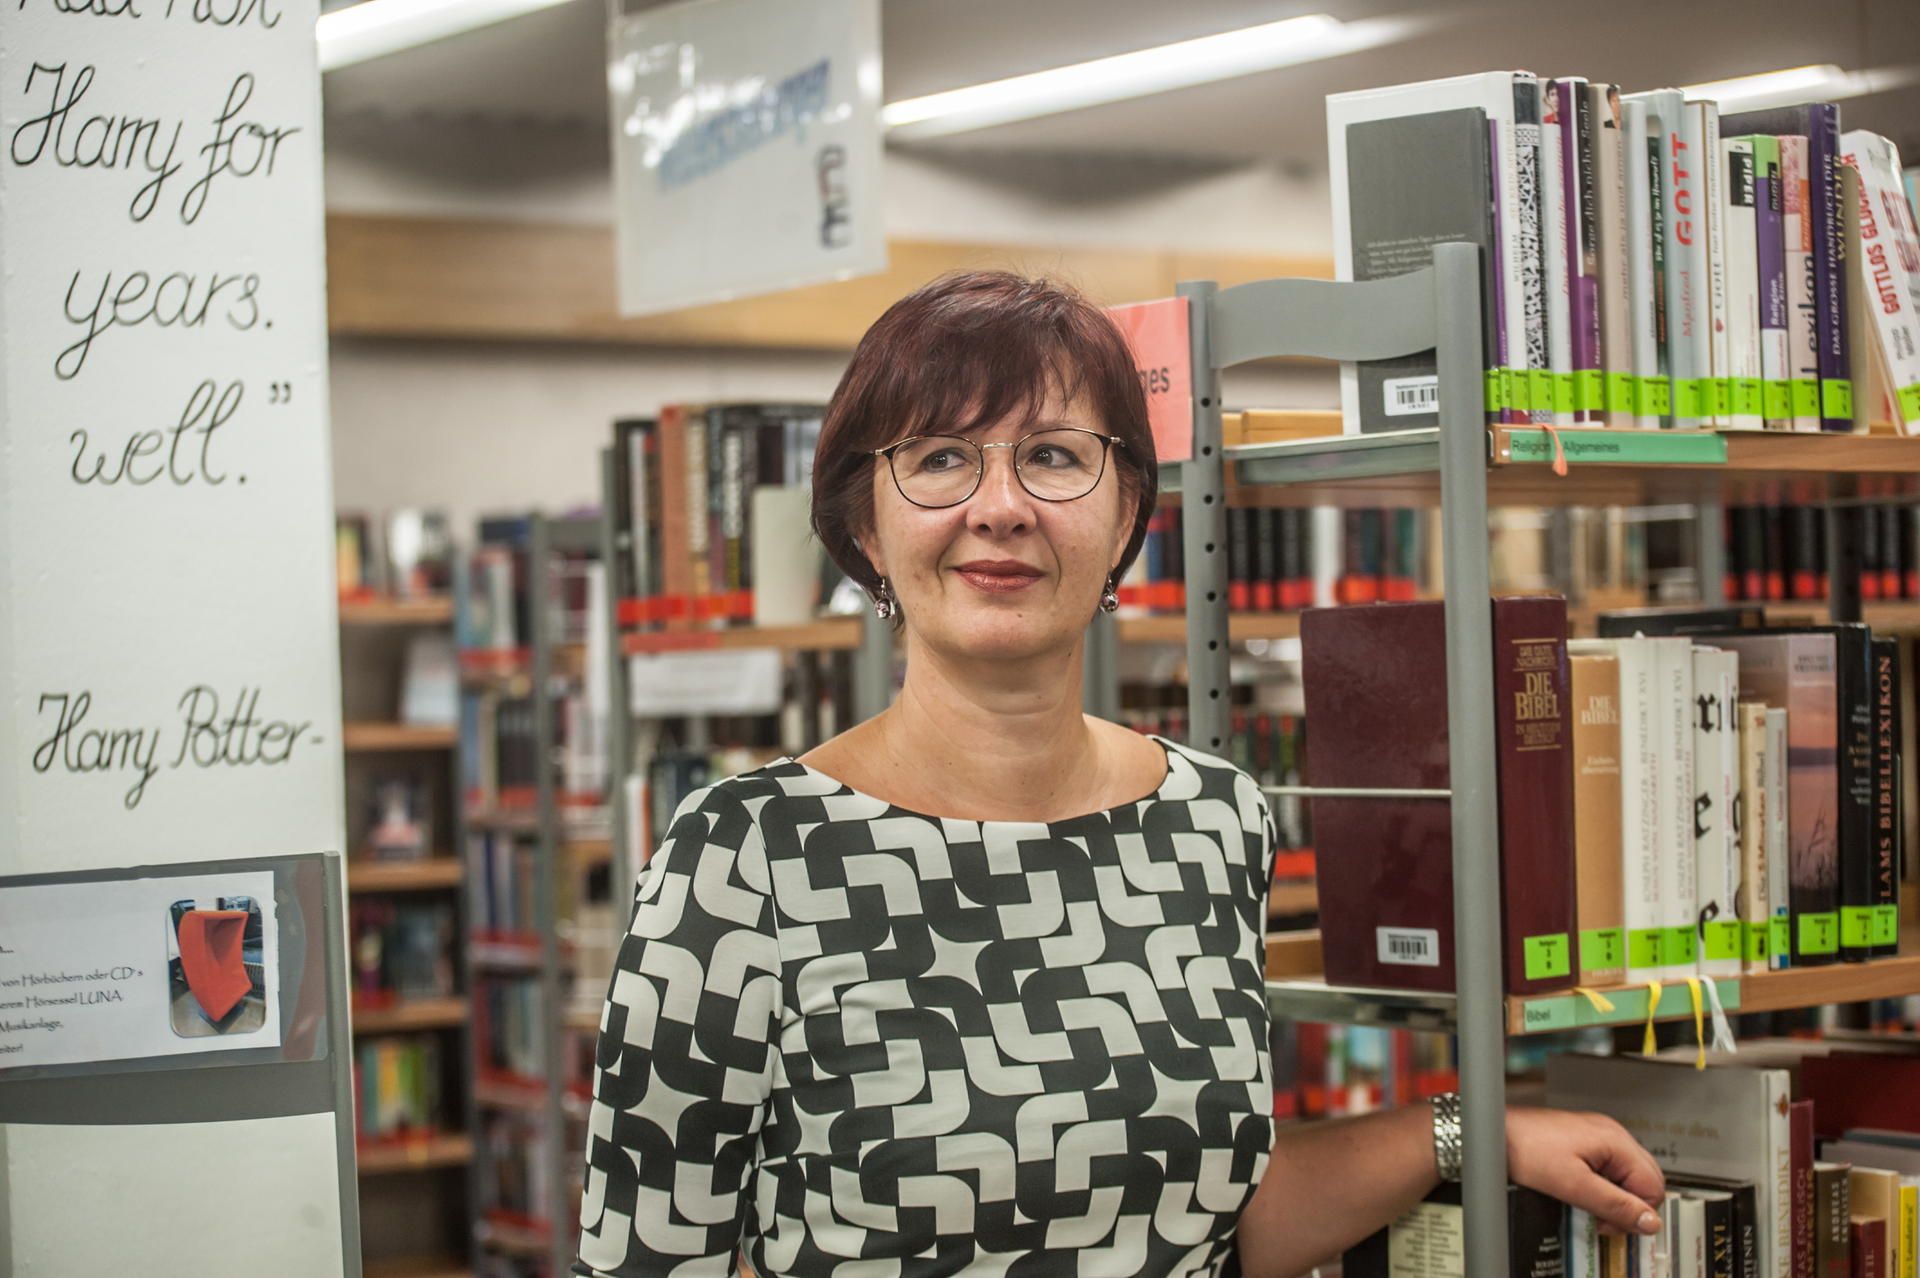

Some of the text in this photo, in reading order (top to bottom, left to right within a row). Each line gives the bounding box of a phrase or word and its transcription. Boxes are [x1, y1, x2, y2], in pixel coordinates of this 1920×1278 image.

[11, 62, 302, 225] Harry for
[1822, 152, 1834, 182] DER
[1671, 132, 1693, 247] GOTT
[1742, 157, 1754, 204] PIPER
[1824, 184, 1839, 269] HANDBUCH
[1833, 155, 1847, 261] WUNDER
[1769, 279, 1780, 326] Religion
[1867, 243, 1901, 316] GOTTLOS
[55, 269, 273, 380] years.
[1514, 691, 1561, 721] BIBEL
[1525, 671, 1552, 696] DIE
[1589, 695, 1611, 711] DIE
[1580, 708, 1618, 725] BIBEL
[33, 690, 160, 810] Harry
[1879, 655, 1892, 830] BIBELLEXIKON
[79, 989, 123, 1005] LUNA
[1526, 1009, 1551, 1023] Bibel
